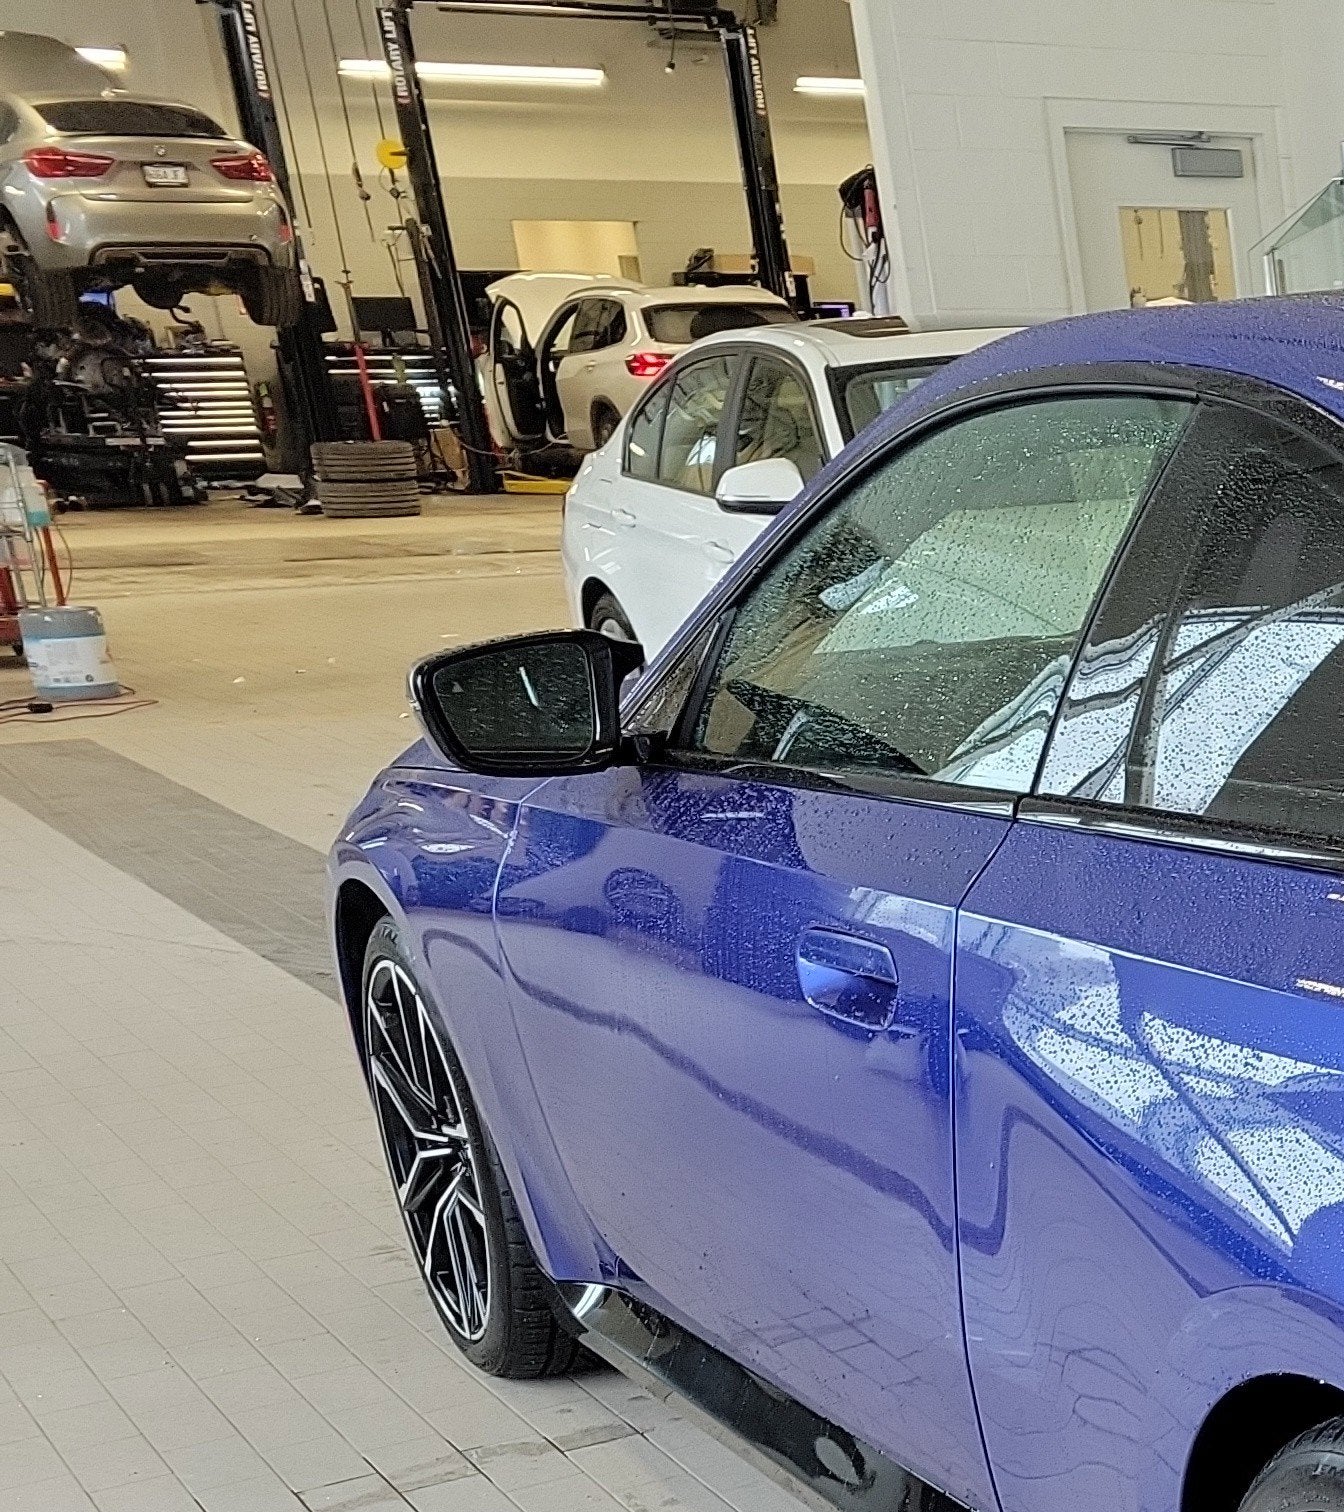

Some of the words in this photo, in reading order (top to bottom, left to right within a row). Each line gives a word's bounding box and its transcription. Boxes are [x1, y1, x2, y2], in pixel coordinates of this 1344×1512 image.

[380, 9, 397, 39] LIFT
[246, 34, 269, 91] ROTARY
[387, 42, 409, 97] ROTARY
